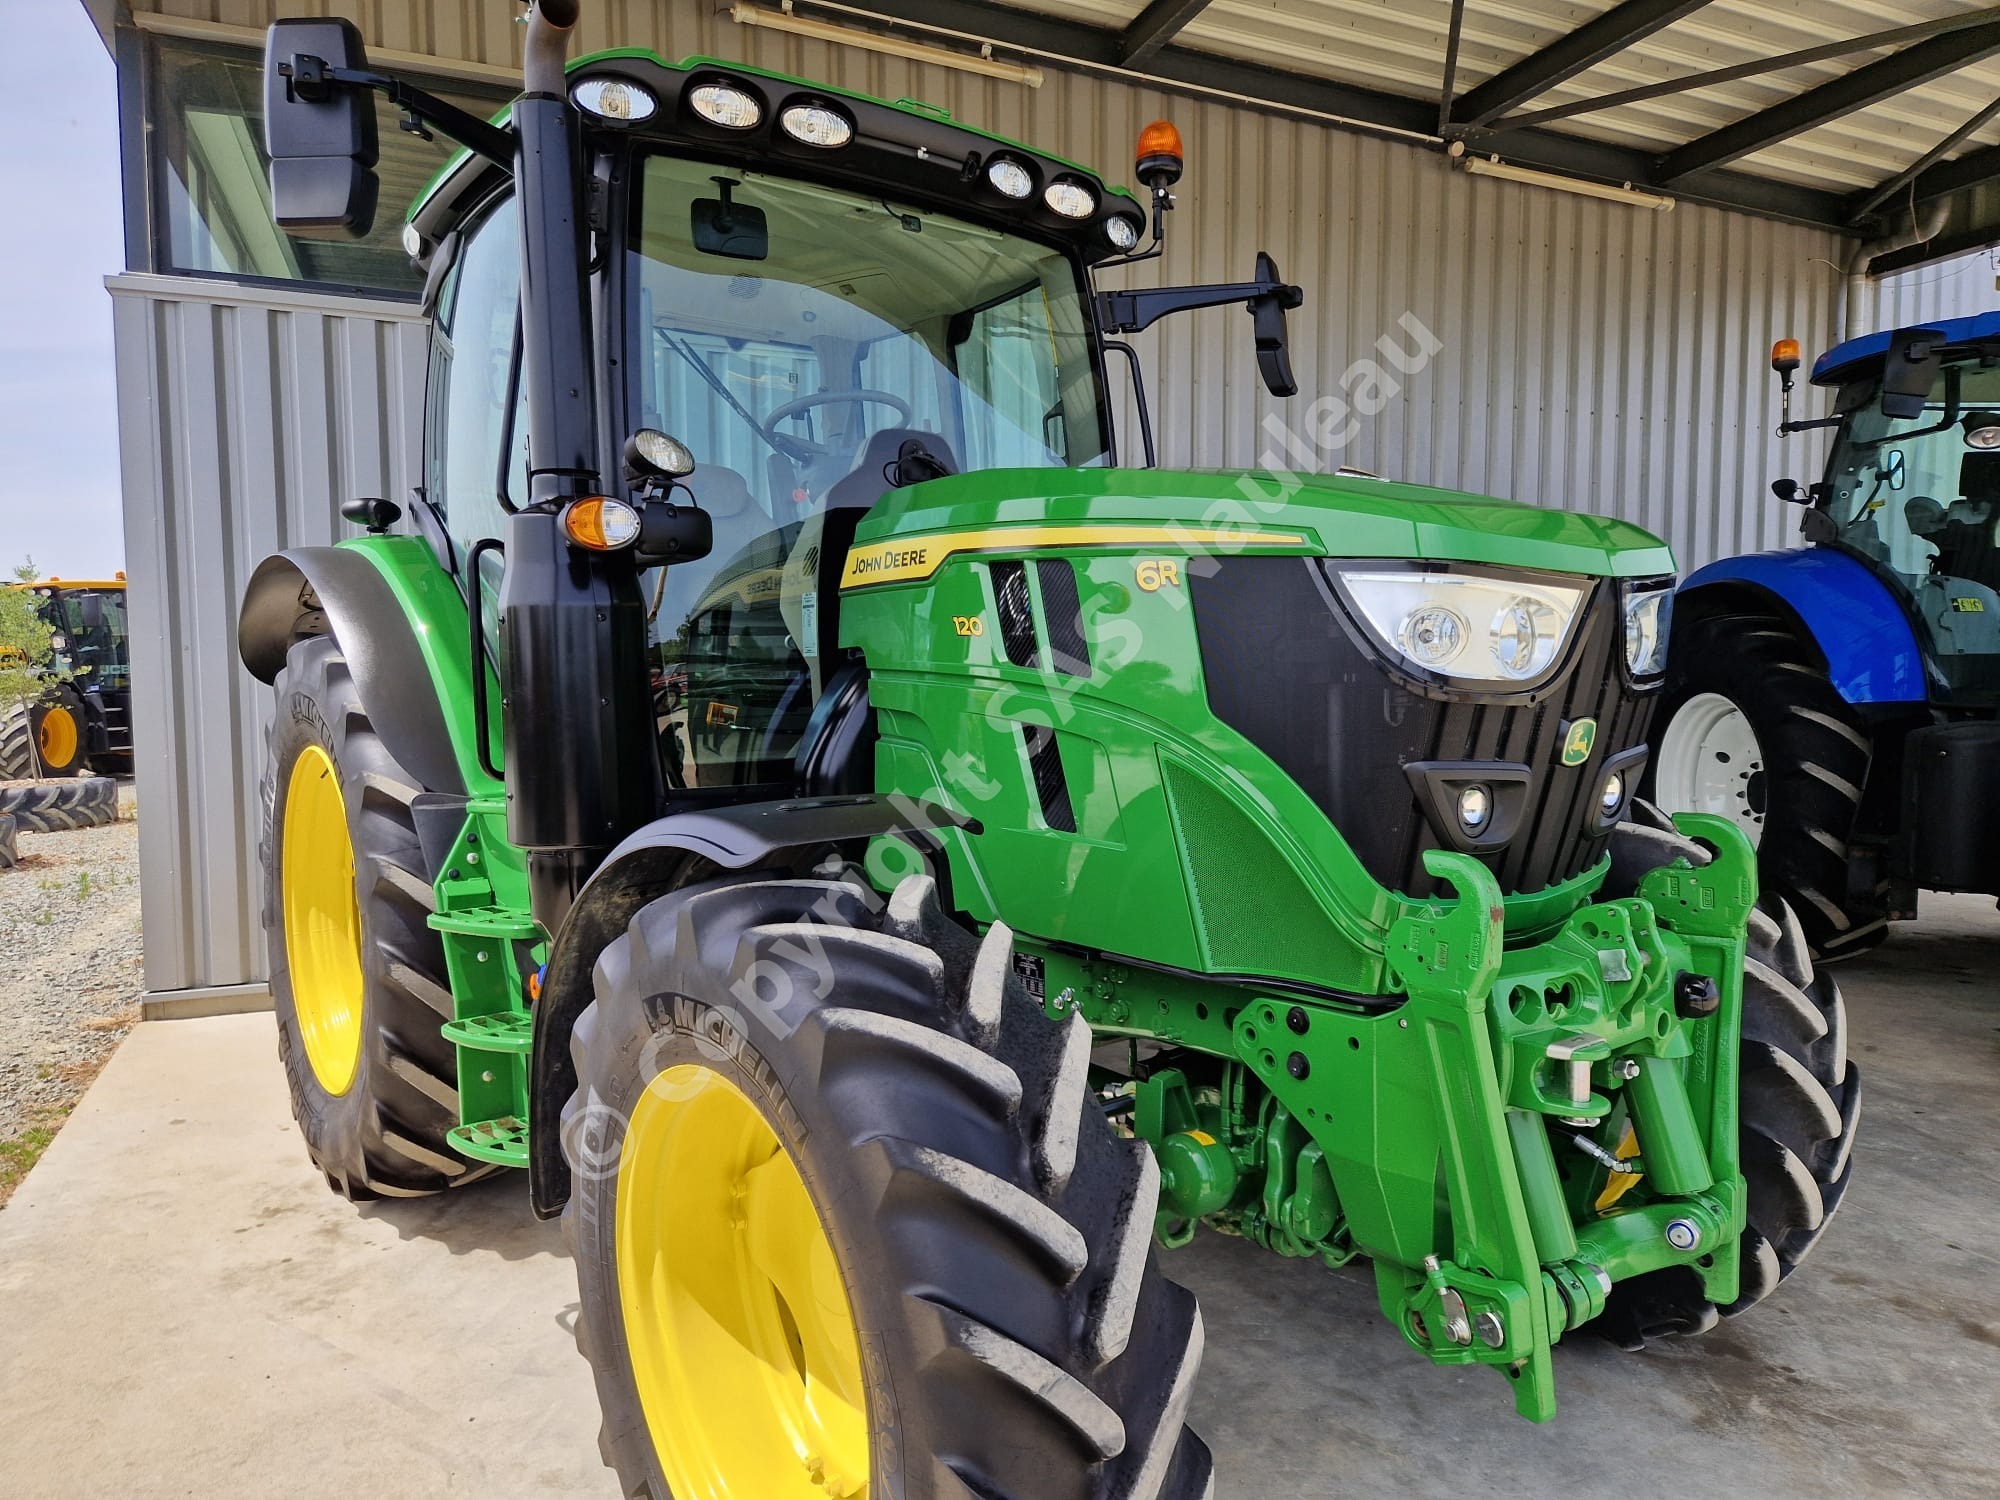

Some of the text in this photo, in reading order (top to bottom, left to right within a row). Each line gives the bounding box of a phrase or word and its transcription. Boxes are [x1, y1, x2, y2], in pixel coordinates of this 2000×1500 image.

[852, 549, 927, 575] JOHN DEERE
[1135, 559, 1180, 592] 6R
[952, 616, 984, 637] 120
[99, 664, 129, 675] JCB
[674, 996, 810, 1143] MICHELIN
